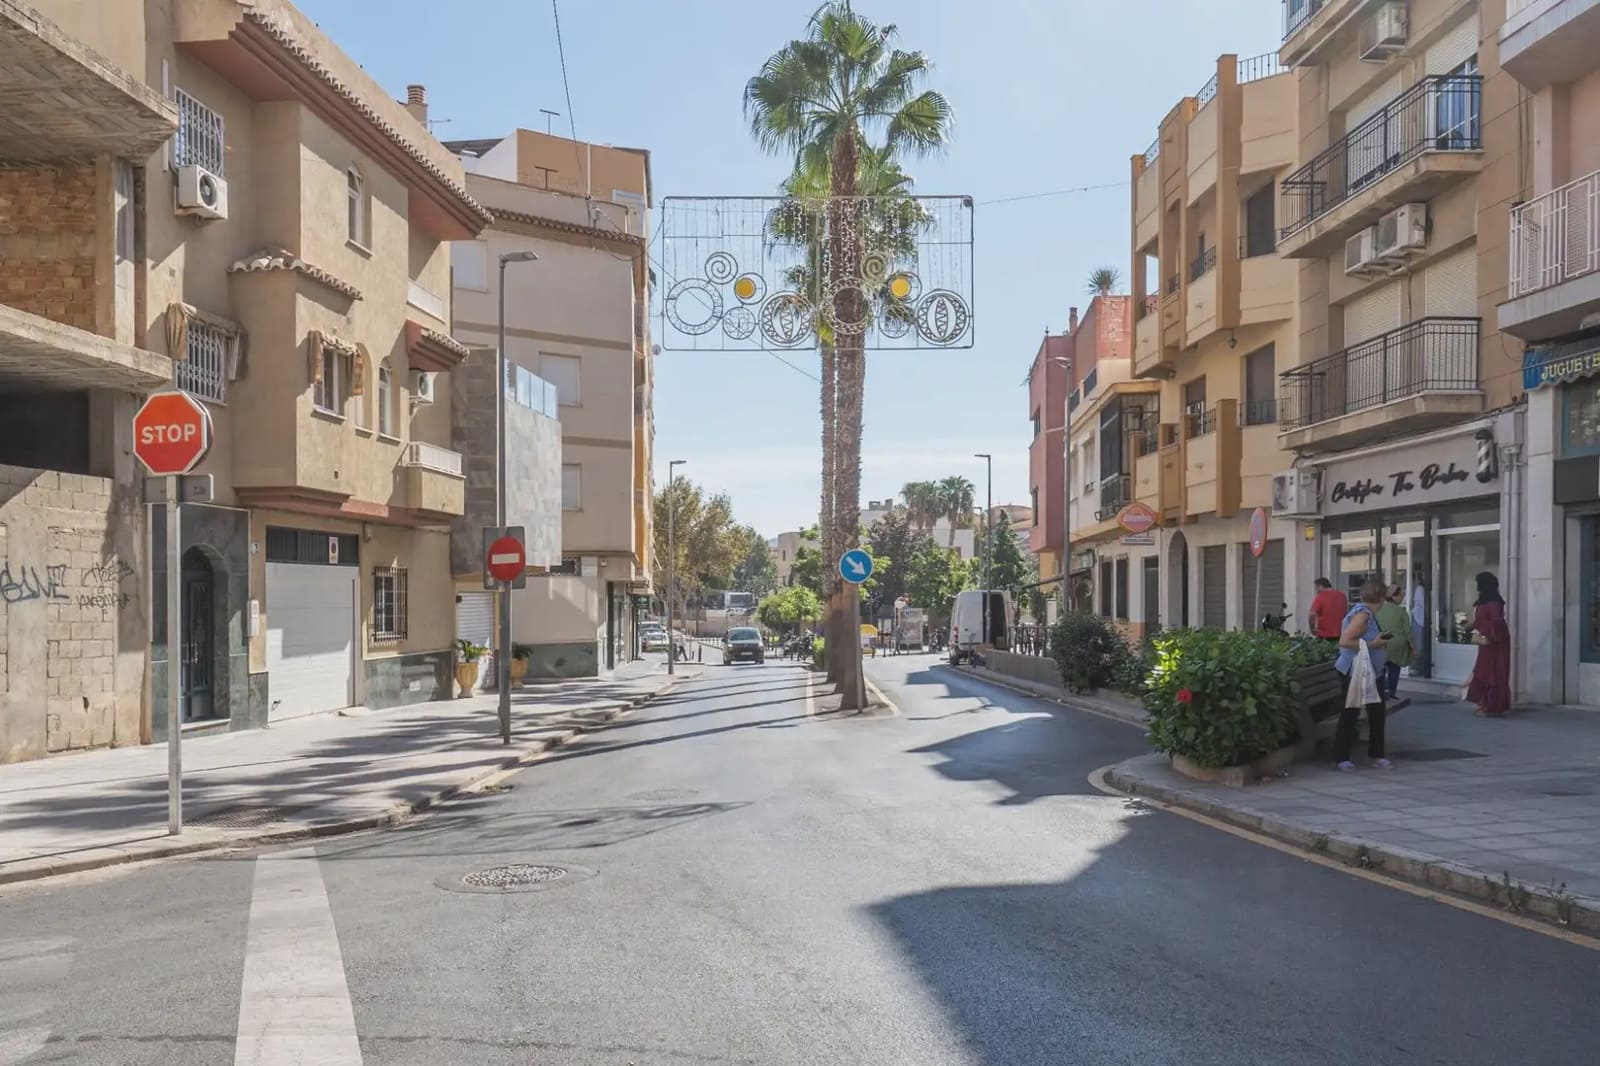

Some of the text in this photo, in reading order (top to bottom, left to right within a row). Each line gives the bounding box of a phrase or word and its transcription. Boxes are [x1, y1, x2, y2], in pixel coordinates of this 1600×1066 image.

[141, 423, 196, 445] STOP
[1388, 470, 1415, 497] The
[1419, 462, 1470, 490] Barber
